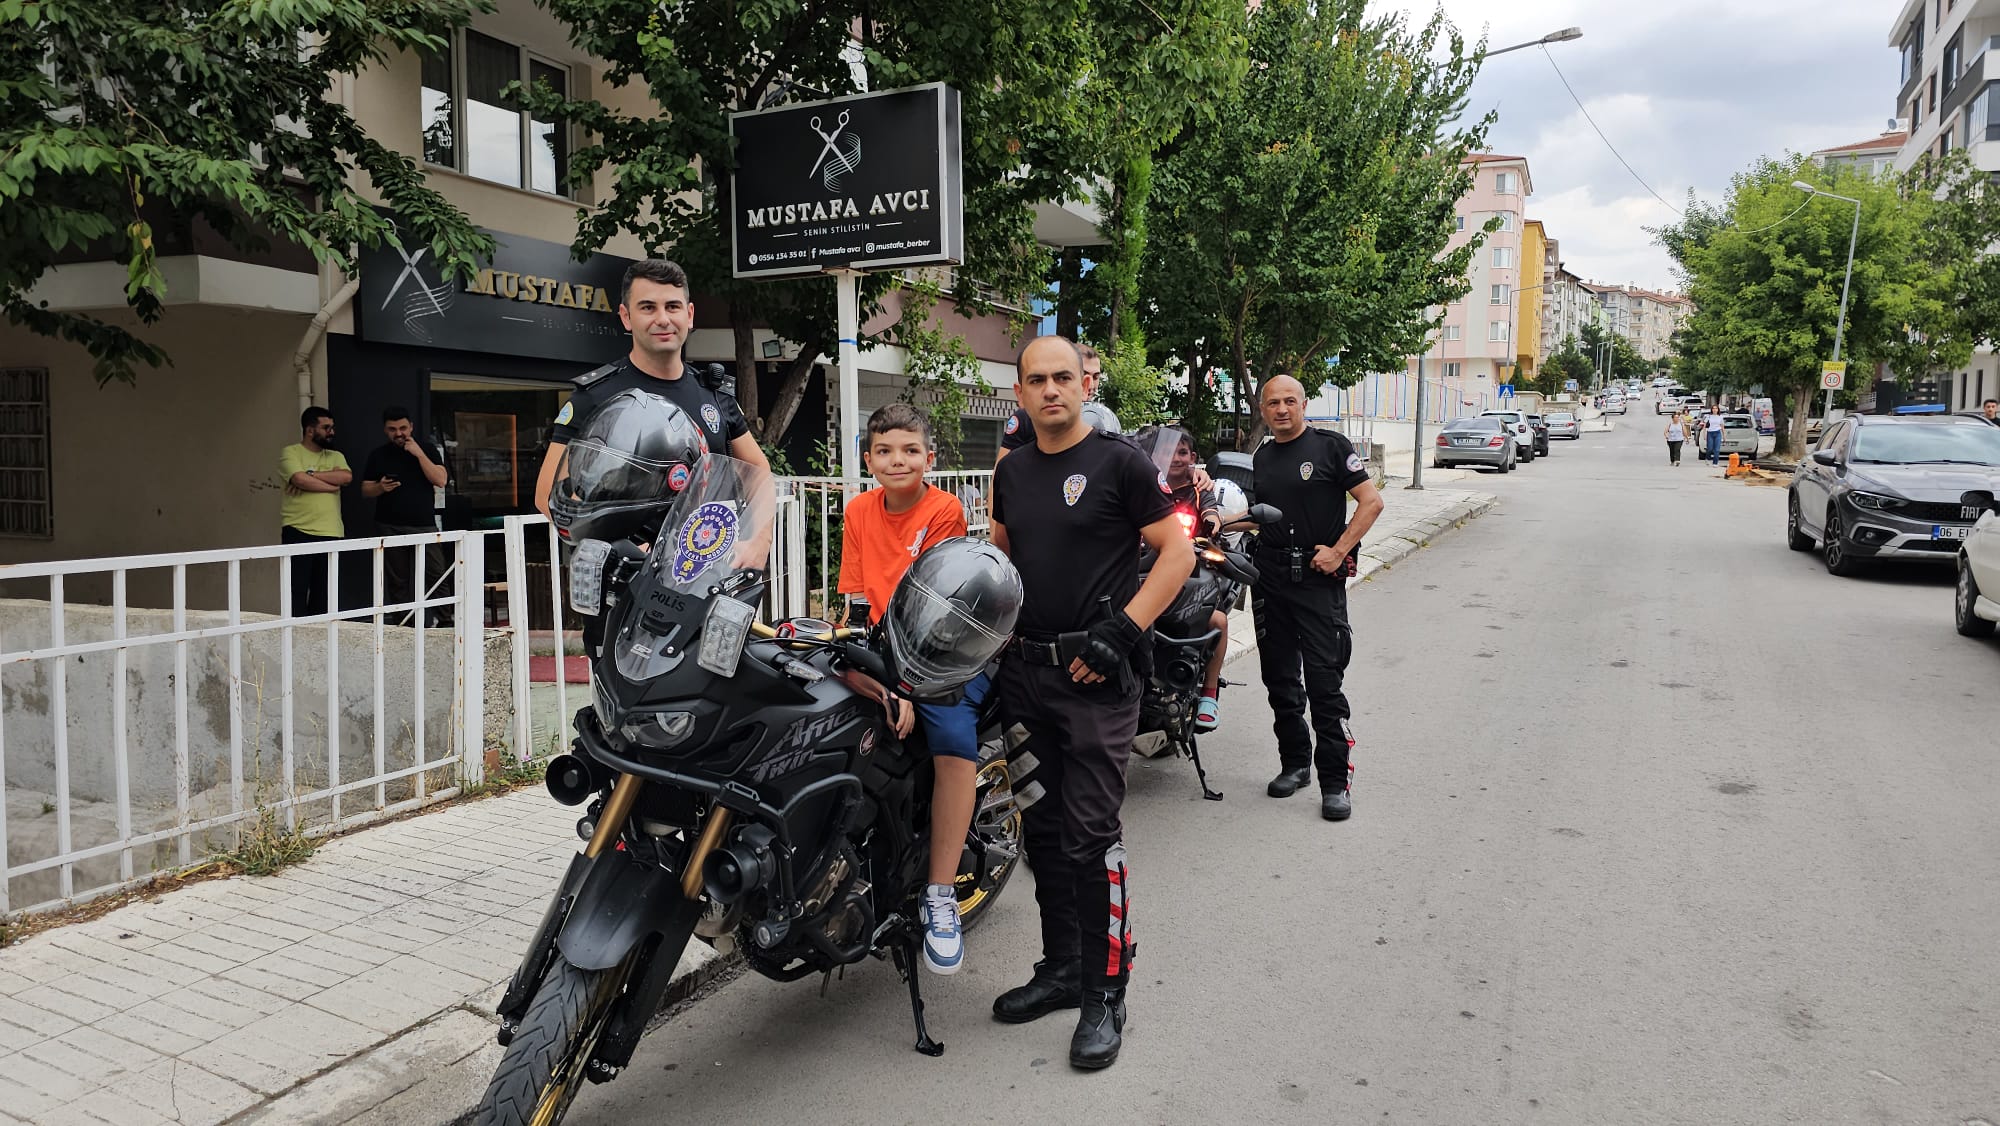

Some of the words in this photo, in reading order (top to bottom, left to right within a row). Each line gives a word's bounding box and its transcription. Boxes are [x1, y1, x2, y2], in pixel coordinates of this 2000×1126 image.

[747, 197, 860, 228] MUSTAFA
[869, 189, 930, 216] AVCI
[803, 226, 828, 237] SENİN
[831, 222, 870, 235] STİLİSTİN
[818, 246, 846, 256] Mustafa
[875, 239, 931, 251] mustafa_berber
[798, 250, 807, 258] 01
[465, 268, 613, 313] MUSTAFA
[1827, 376, 1838, 384] 30
[704, 505, 733, 523] POLİS
[1960, 505, 1980, 519] FIAT
[1939, 527, 1952, 538] 06
[650, 590, 686, 613] POLİS
[766, 705, 858, 750] Africa
[746, 749, 816, 783] Twin
